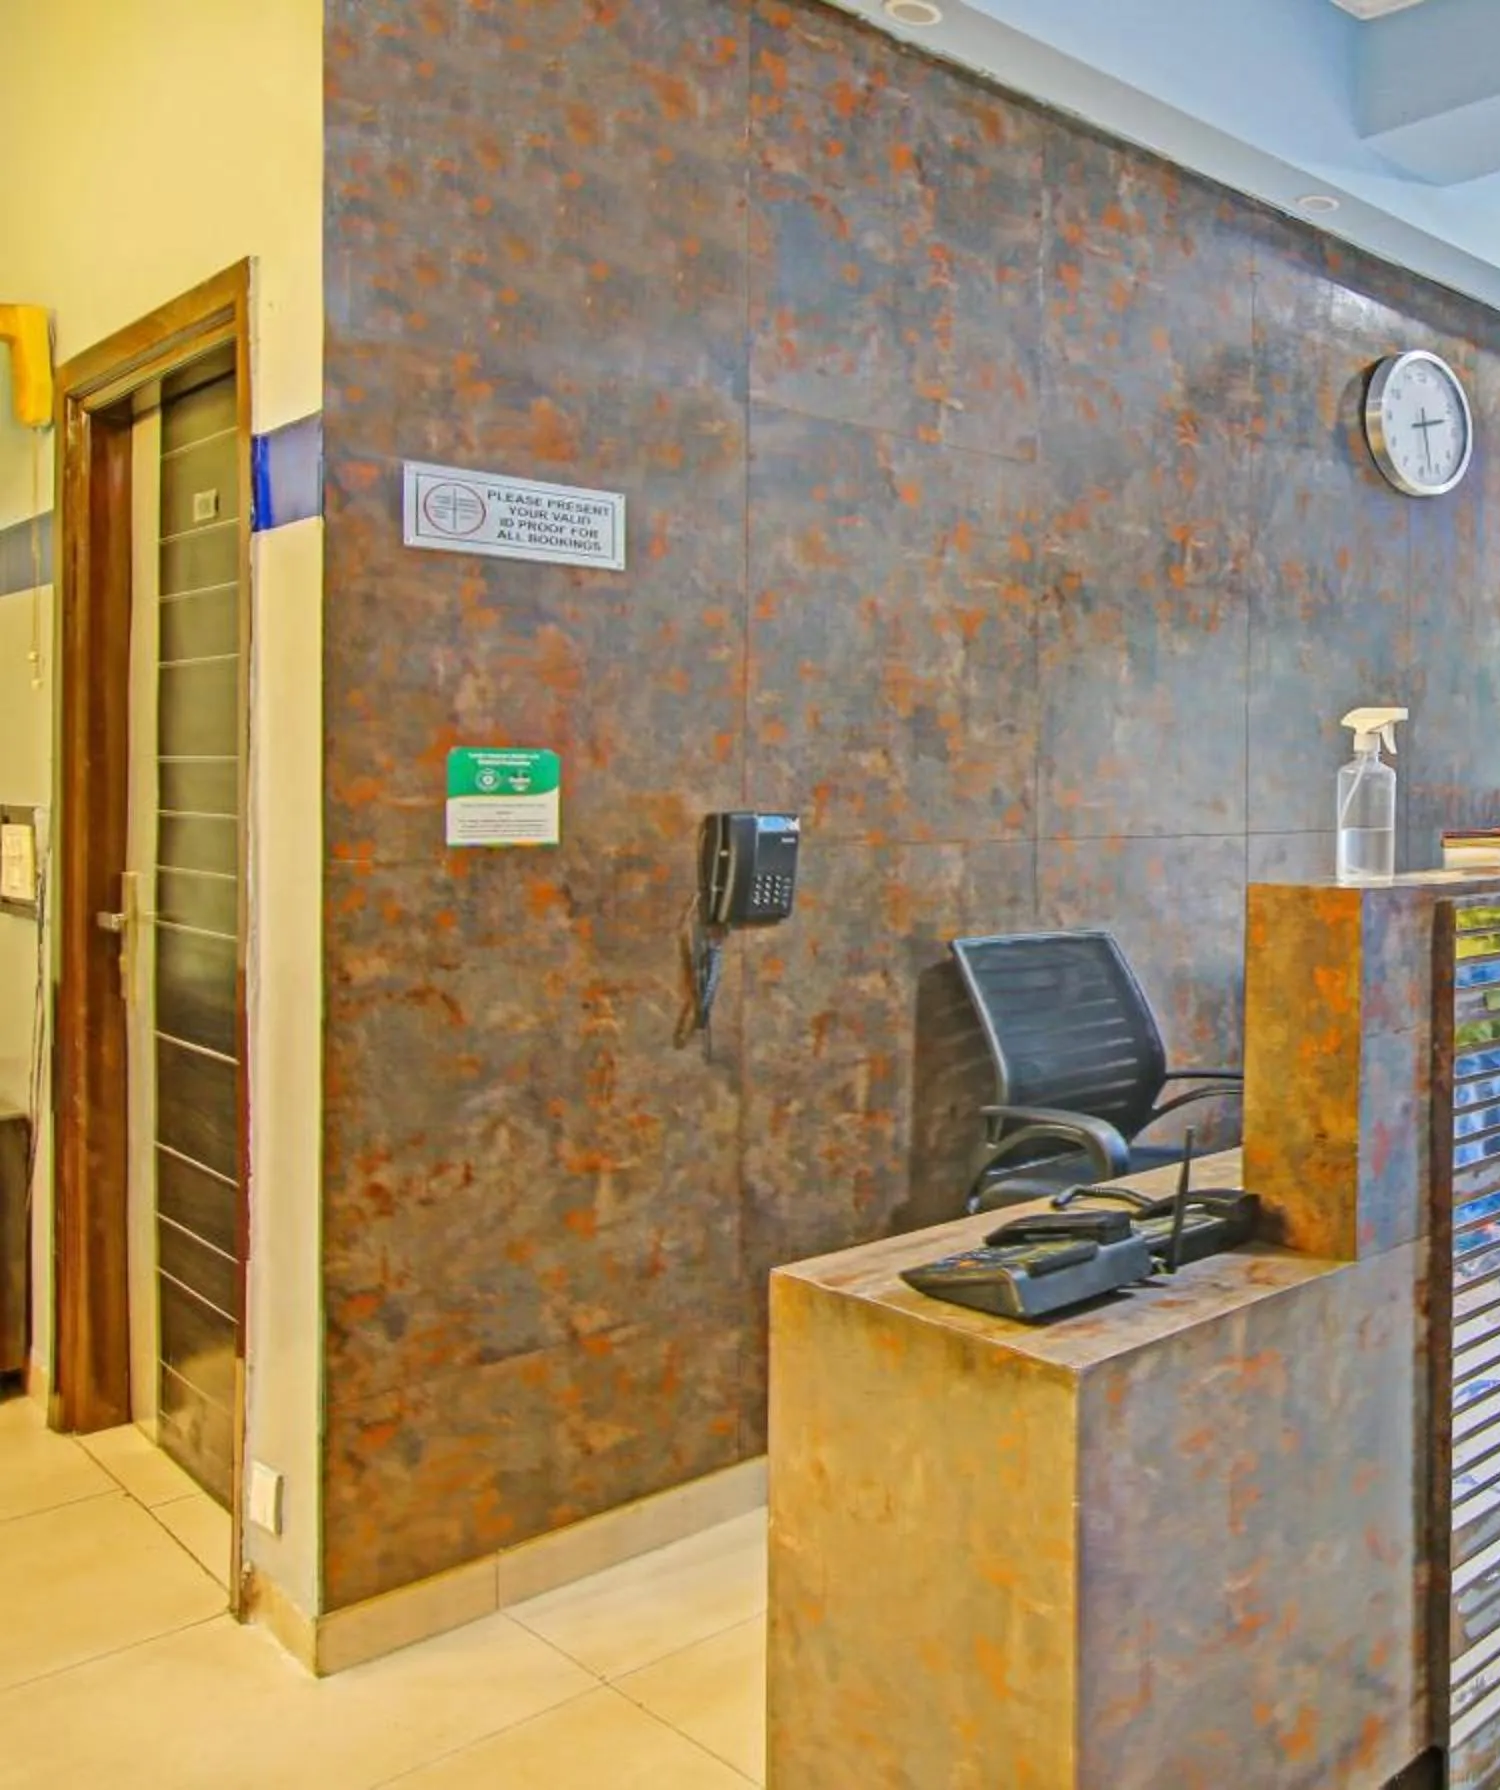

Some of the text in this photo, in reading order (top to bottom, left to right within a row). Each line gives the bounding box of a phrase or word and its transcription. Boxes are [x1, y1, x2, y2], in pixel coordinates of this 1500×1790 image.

[487, 490, 609, 516] PLEASE PRESENT
[509, 505, 592, 525] YOUR VALID
[499, 517, 599, 540] ID PROOF FOR
[496, 529, 602, 551] ALL BOOKINGS
